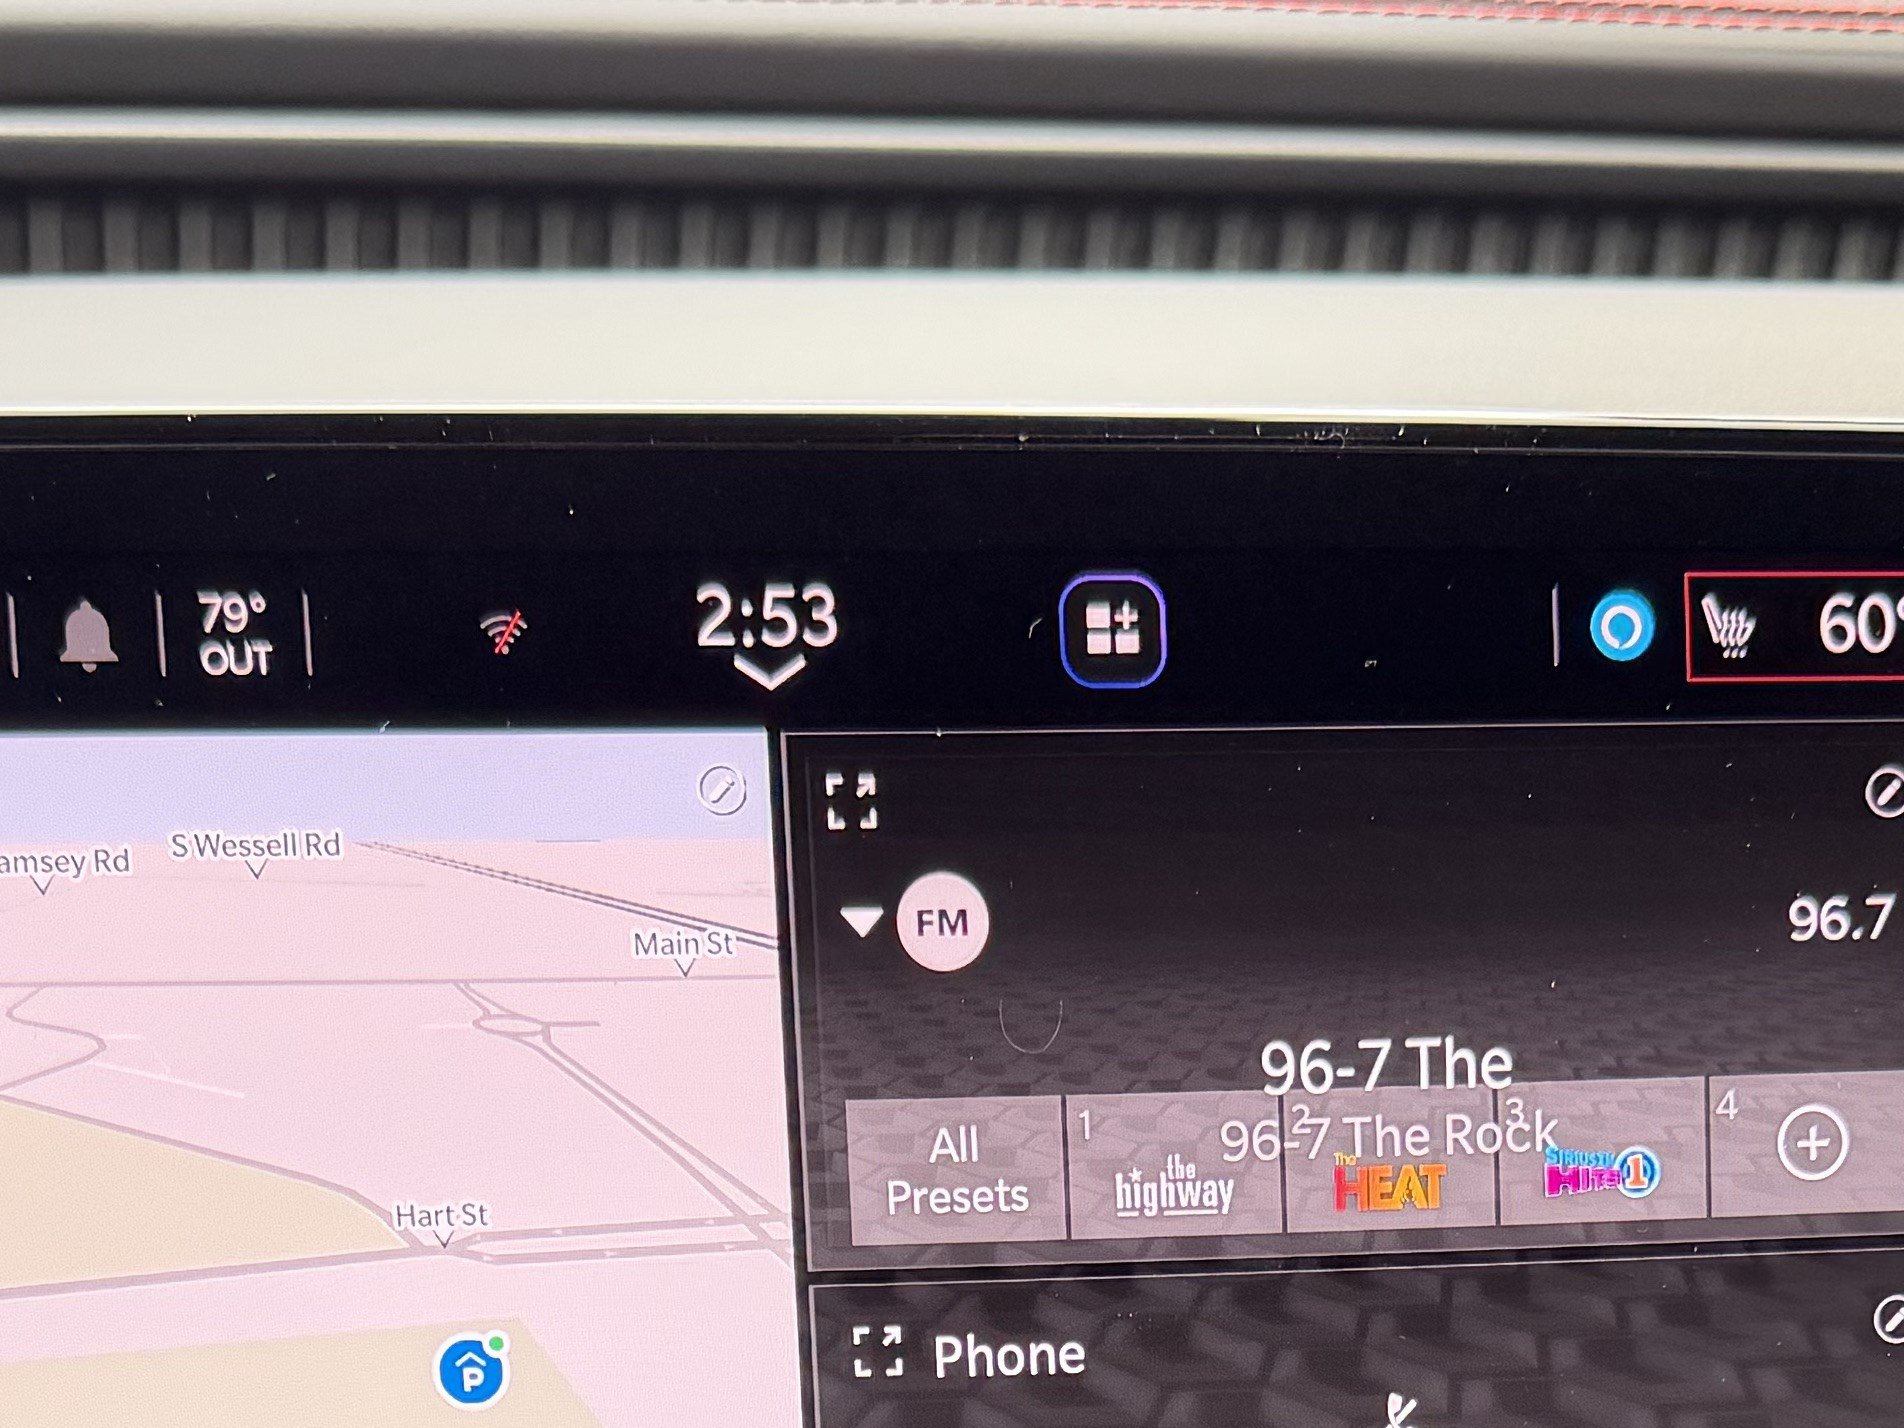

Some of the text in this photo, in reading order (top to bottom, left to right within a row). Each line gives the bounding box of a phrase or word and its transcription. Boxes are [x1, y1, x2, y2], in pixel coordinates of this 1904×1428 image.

[197, 590, 267, 634] 79°
[696, 582, 838, 648] 2:53
[198, 638, 273, 676] OUT
[94, 847, 130, 874] Rd
[171, 832, 342, 859] S Wessell Rd
[916, 909, 969, 937] FM
[1788, 895, 1896, 942] 96.7
[633, 931, 734, 958] Main St
[1261, 1035, 1513, 1097] 96-7 The
[1715, 1088, 1739, 1120] 4
[1078, 1110, 1091, 1141] 1
[1220, 1108, 1558, 1162] 96-7 The Rock
[929, 1126, 979, 1164] All
[1166, 1153, 1196, 1180] the
[887, 1179, 1030, 1217] Presets
[1115, 1170, 1235, 1217] highway
[1333, 1162, 1447, 1213] HEAT
[395, 1202, 488, 1229] Hart St
[935, 1333, 1086, 1379] Phone
